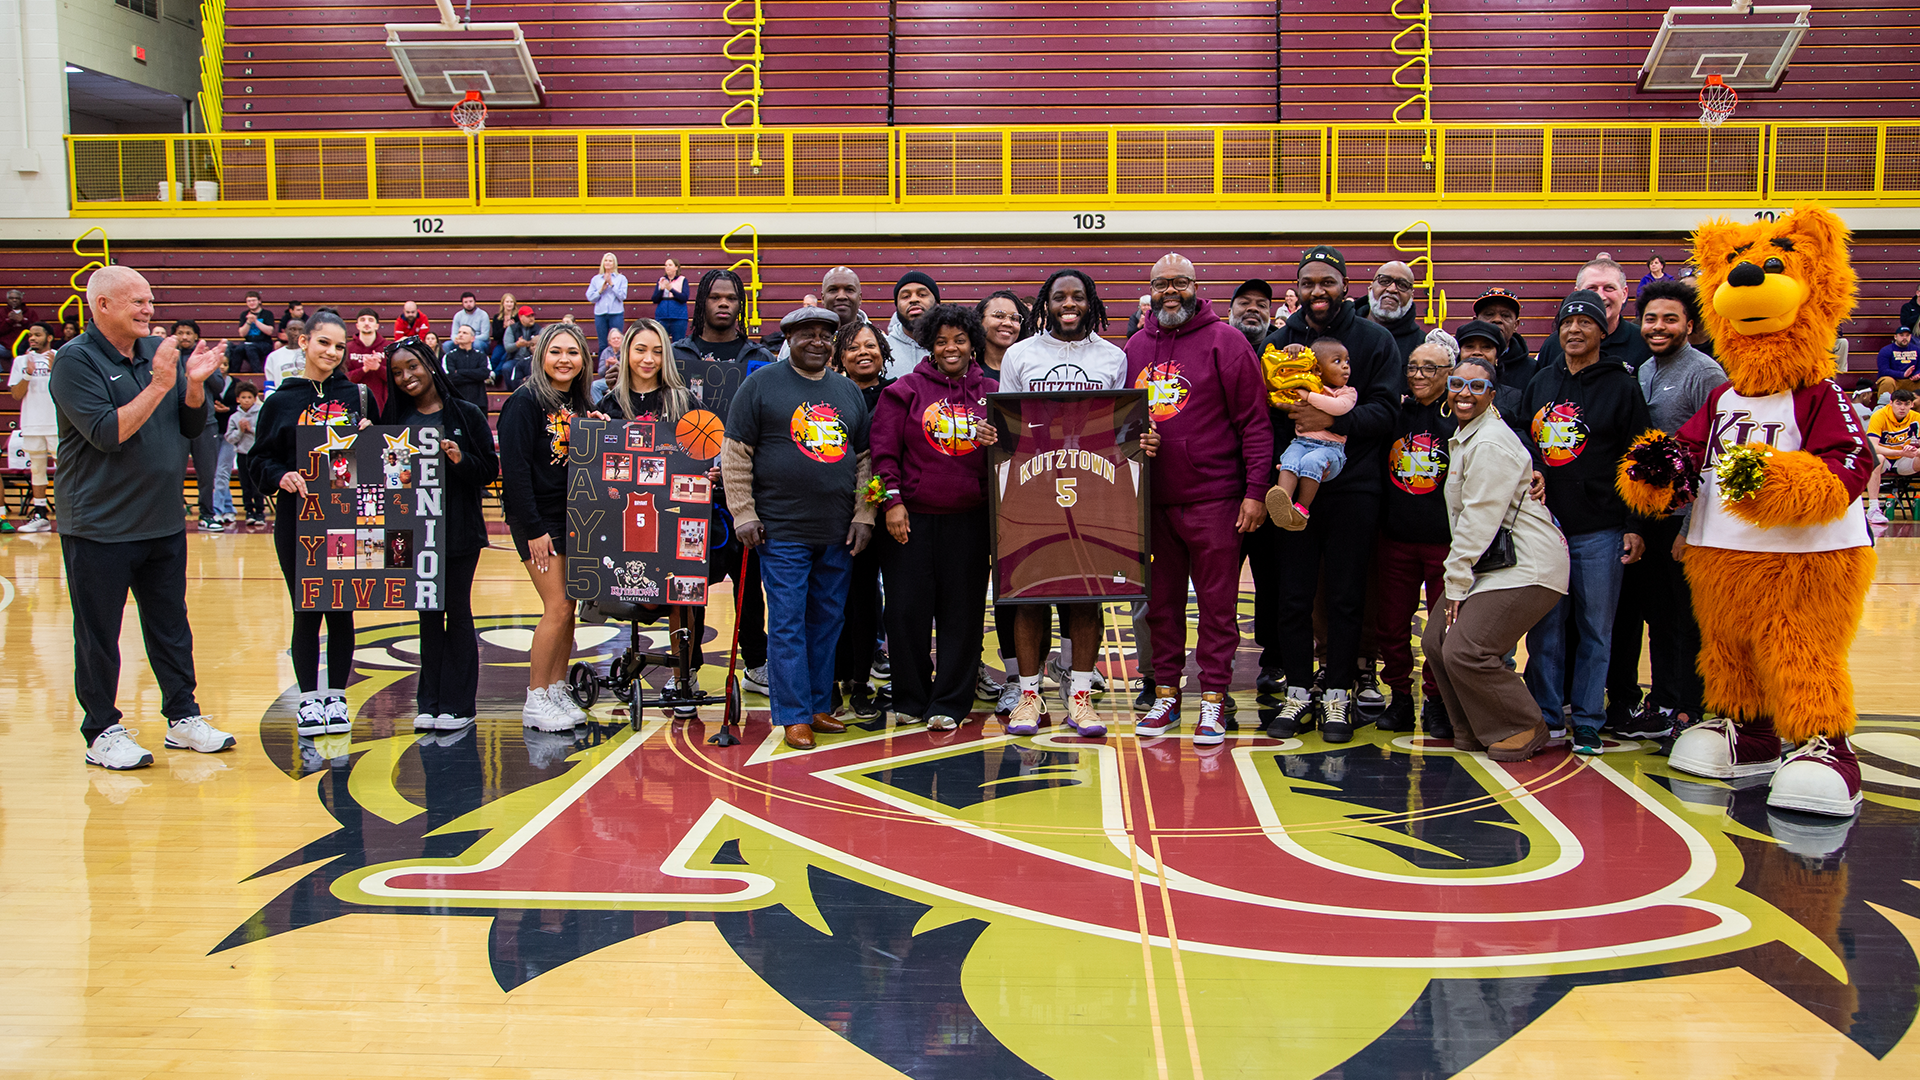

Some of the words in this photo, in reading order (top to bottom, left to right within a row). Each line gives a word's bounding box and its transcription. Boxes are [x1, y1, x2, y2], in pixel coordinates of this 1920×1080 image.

[412, 218, 444, 234] 102
[1073, 214, 1106, 230] 103
[1754, 211, 1786, 224] 10
[1019, 448, 1116, 485] KUTZTOWN
[330, 492, 351, 515] KU
[392, 493, 410, 515] 25
[1055, 477, 1078, 508] 5
[298, 450, 325, 566] JAY
[414, 426, 443, 609] SENIOR
[636, 513, 646, 527] 5
[301, 577, 406, 609] FIVE
